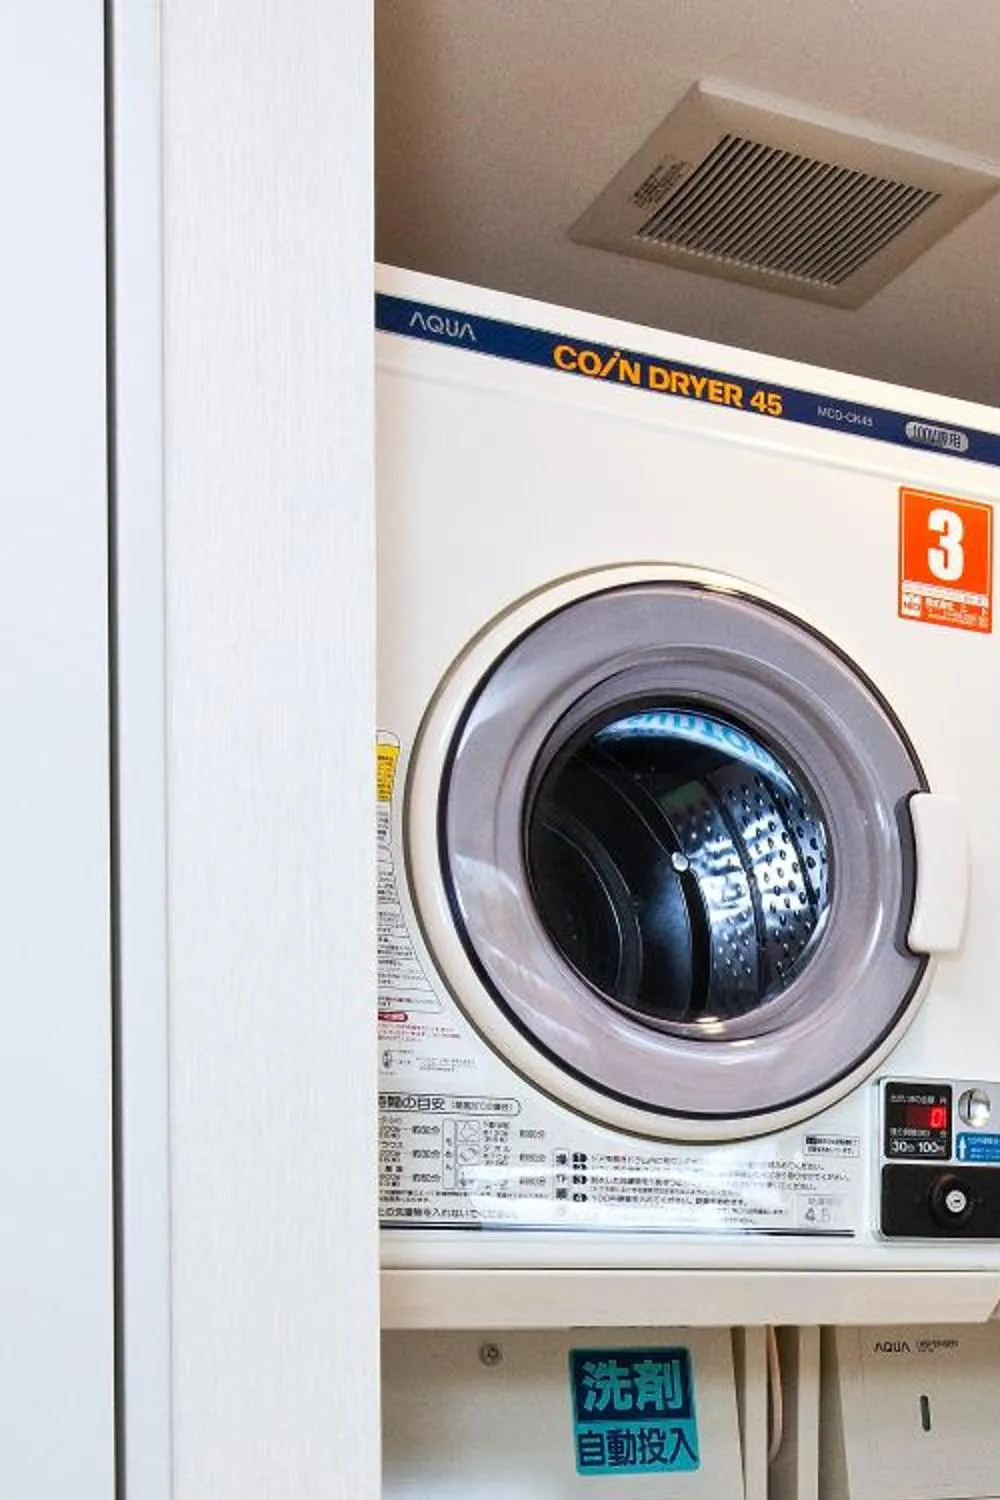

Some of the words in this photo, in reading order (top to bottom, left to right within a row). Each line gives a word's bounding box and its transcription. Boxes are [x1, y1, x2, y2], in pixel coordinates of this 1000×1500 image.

[409, 311, 477, 342] AQUA
[647, 367, 745, 409] DRYER
[750, 389, 783, 417] 45
[927, 508, 965, 582] 3
[930, 1107, 947, 1128] 0
[873, 1341, 911, 1353] AQUA
[581, 1359, 684, 1412] 洗剤
[578, 1426, 698, 1467] 自動投入
